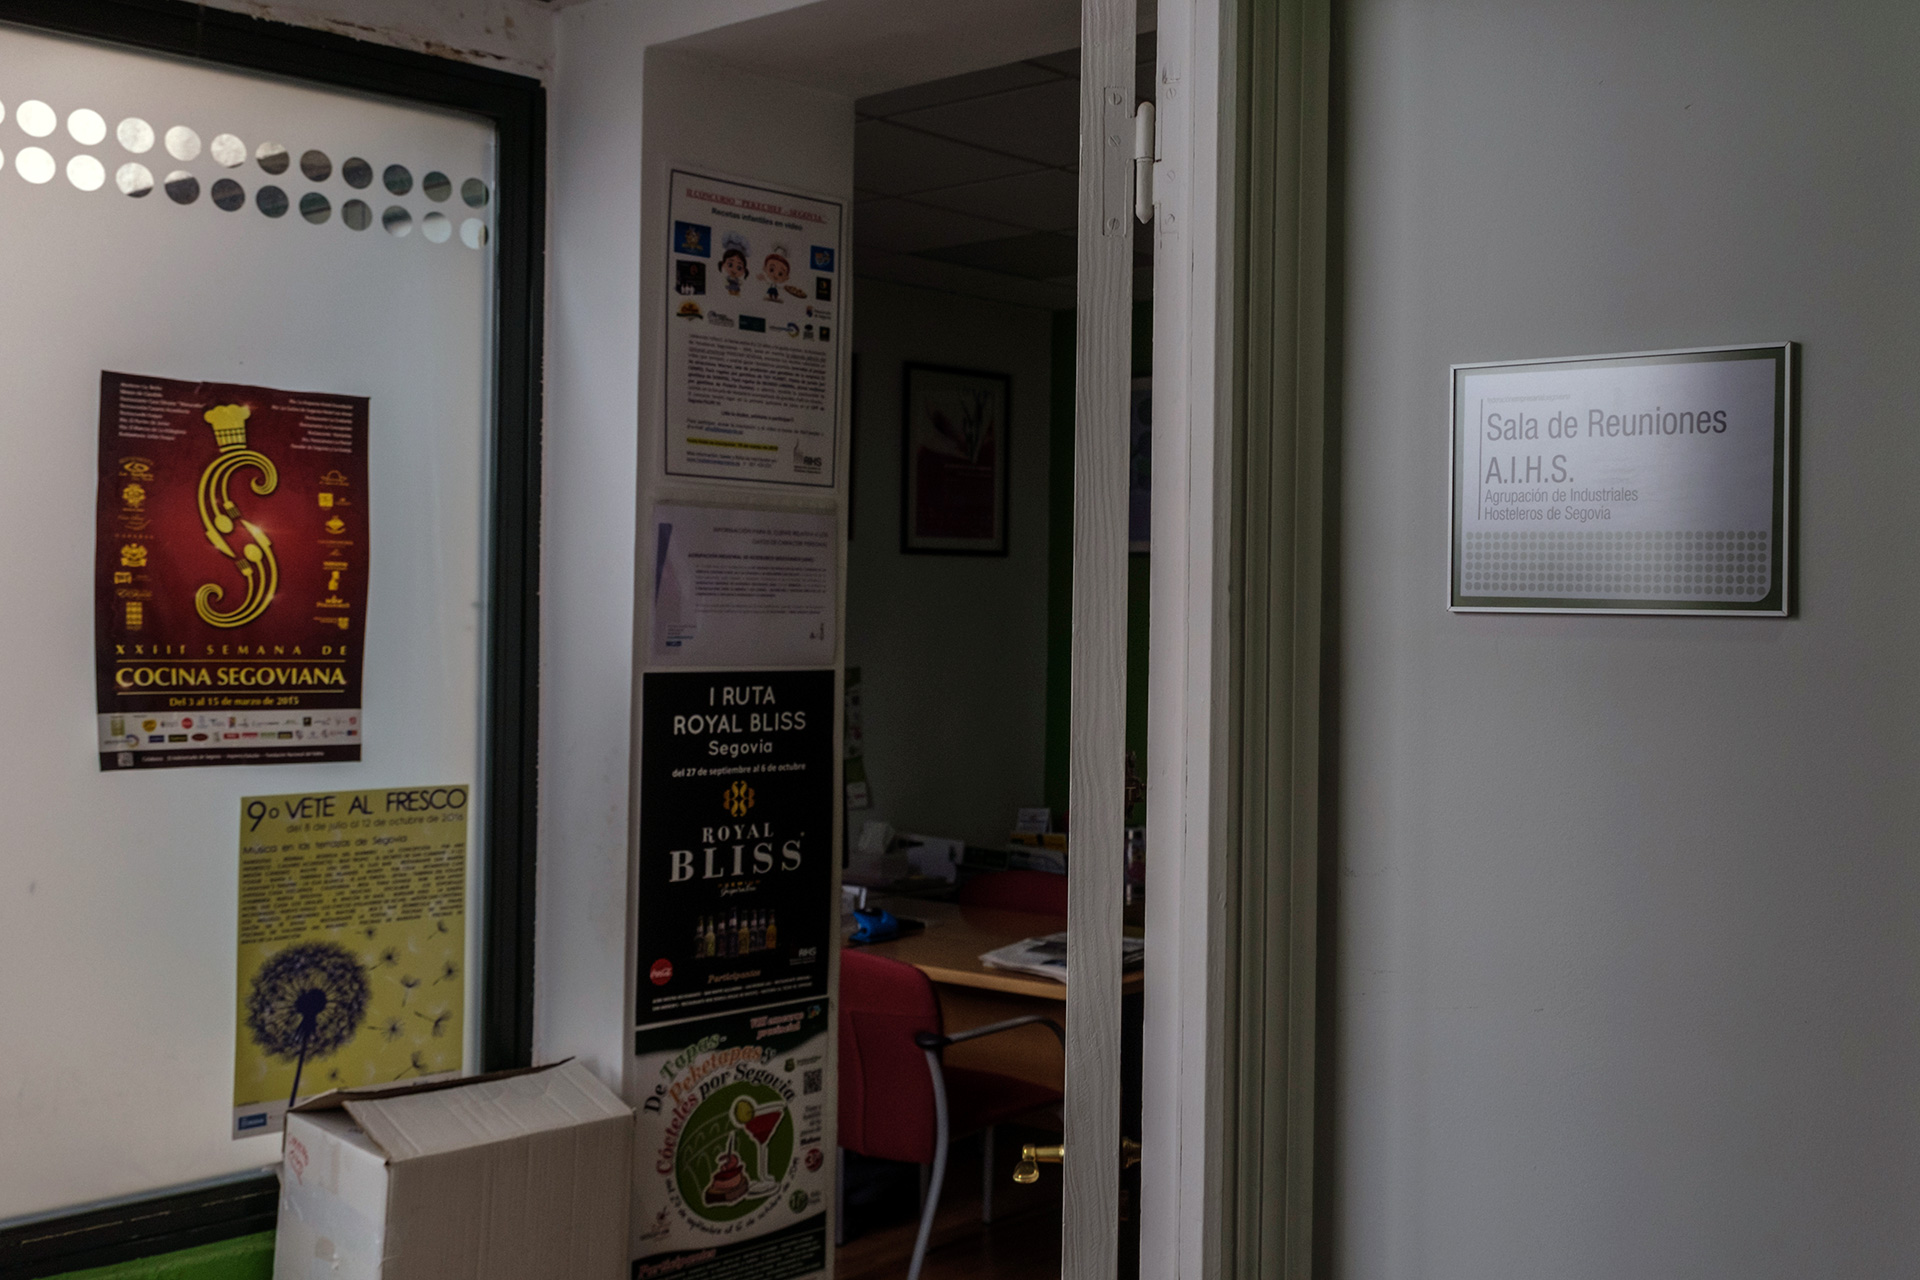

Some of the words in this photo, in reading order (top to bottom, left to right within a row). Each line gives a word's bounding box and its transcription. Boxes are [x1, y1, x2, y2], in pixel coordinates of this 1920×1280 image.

[1486, 412, 1539, 441] Sala
[1548, 410, 1578, 439] de
[1588, 406, 1728, 438] Reuniones
[1485, 454, 1575, 485] A.I.H.S.
[1484, 488, 1549, 507] Agrupación
[1552, 488, 1567, 503] de
[1570, 487, 1639, 502] Industriales
[1484, 506, 1543, 521] Hosteleros
[1546, 506, 1562, 520] de
[1564, 505, 1612, 523] Segovia
[206, 645, 303, 656] SEMANA
[321, 645, 347, 656] DE
[115, 667, 213, 688] COCINA
[217, 666, 348, 686] SEGOVIANA
[169, 697, 186, 707] Del
[188, 697, 194, 706] 3
[196, 697, 206, 706] al
[207, 697, 221, 706] 15
[221, 696, 233, 705] de
[234, 697, 261, 706] marzo
[262, 696, 275, 705] de
[709, 687, 715, 707] I
[722, 685, 776, 706] RUTA
[673, 713, 743, 736] ROYAL
[750, 710, 807, 733] BLISS
[707, 737, 774, 759] Segovia
[672, 767, 685, 778] del
[686, 767, 697, 777] 27
[697, 767, 708, 777] de
[709, 764, 752, 777] septiembre
[752, 763, 760, 773] al
[761, 763, 767, 773] 6
[767, 762, 777, 772] de
[778, 760, 806, 773] octubre
[285, 795, 337, 820] VETE
[348, 795, 375, 816] AL
[387, 788, 468, 812] FRESCO
[374, 816, 387, 828] de
[388, 814, 426, 827] octubre
[426, 814, 440, 825] de
[282, 844, 295, 852] en
[298, 841, 311, 852] las
[315, 838, 352, 850] terrazas
[355, 836, 368, 848] de
[373, 833, 409, 848] Segovia
[702, 822, 775, 844] ROYAL
[669, 839, 802, 883] BLISS
[670, 1044, 764, 1105] Peketapas
[699, 1066, 730, 1101] por
[734, 1063, 797, 1102] Segovia
[644, 1083, 668, 1114] De
